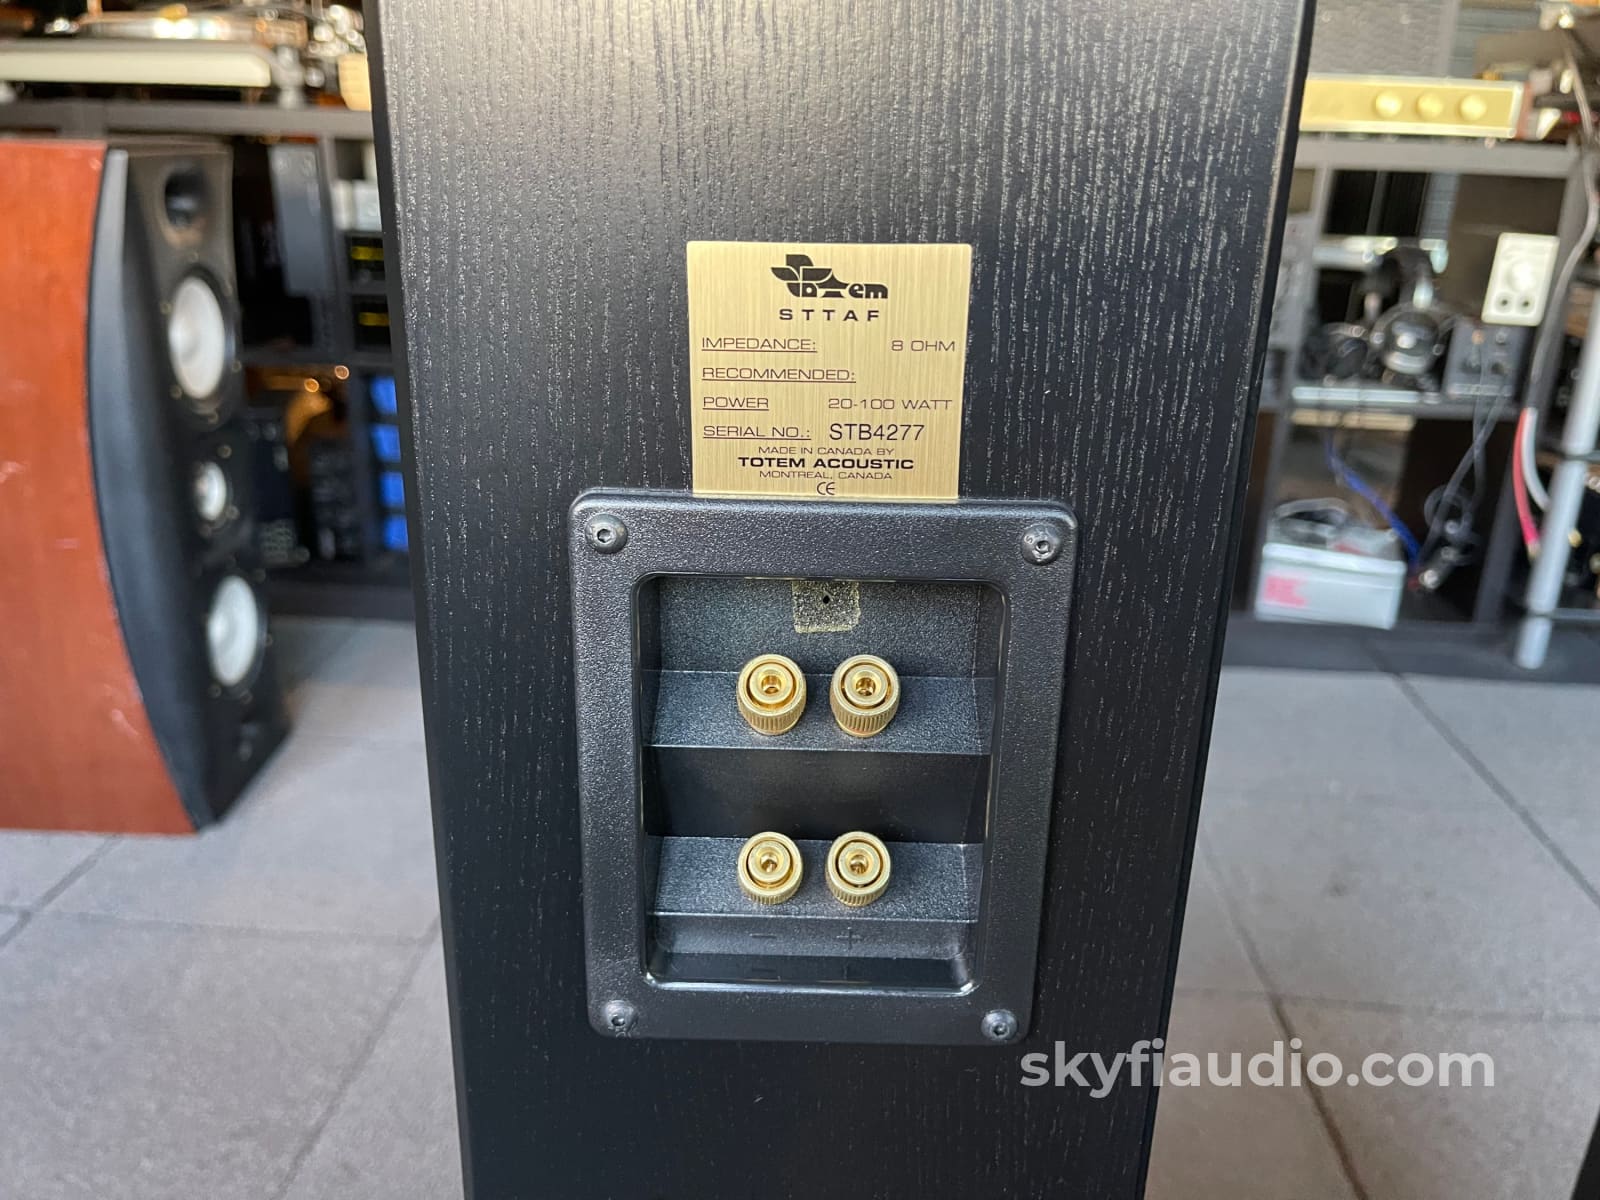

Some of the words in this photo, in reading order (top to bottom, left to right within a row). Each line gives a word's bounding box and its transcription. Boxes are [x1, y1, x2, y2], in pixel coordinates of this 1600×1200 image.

[779, 308, 880, 321] STTAF
[702, 337, 816, 350] IMPEDANCE:
[891, 340, 903, 352] 8
[910, 340, 956, 351] OHM
[702, 367, 855, 381] RECOMMENDED:
[703, 397, 769, 409] POWER
[828, 398, 895, 410] 20-100
[901, 399, 953, 410] WATT
[703, 425, 766, 437] SERIAL
[771, 426, 811, 438] NO.:
[829, 423, 925, 440] STB4277
[758, 446, 796, 455] MADE
[800, 446, 813, 455] IN
[817, 447, 872, 456] CANADA
[876, 448, 894, 456] BY
[738, 457, 805, 468] TOTEM
[813, 458, 914, 470] ACOUSTIC
[759, 471, 833, 480] MONTREAL,
[838, 472, 892, 480] CANADA
